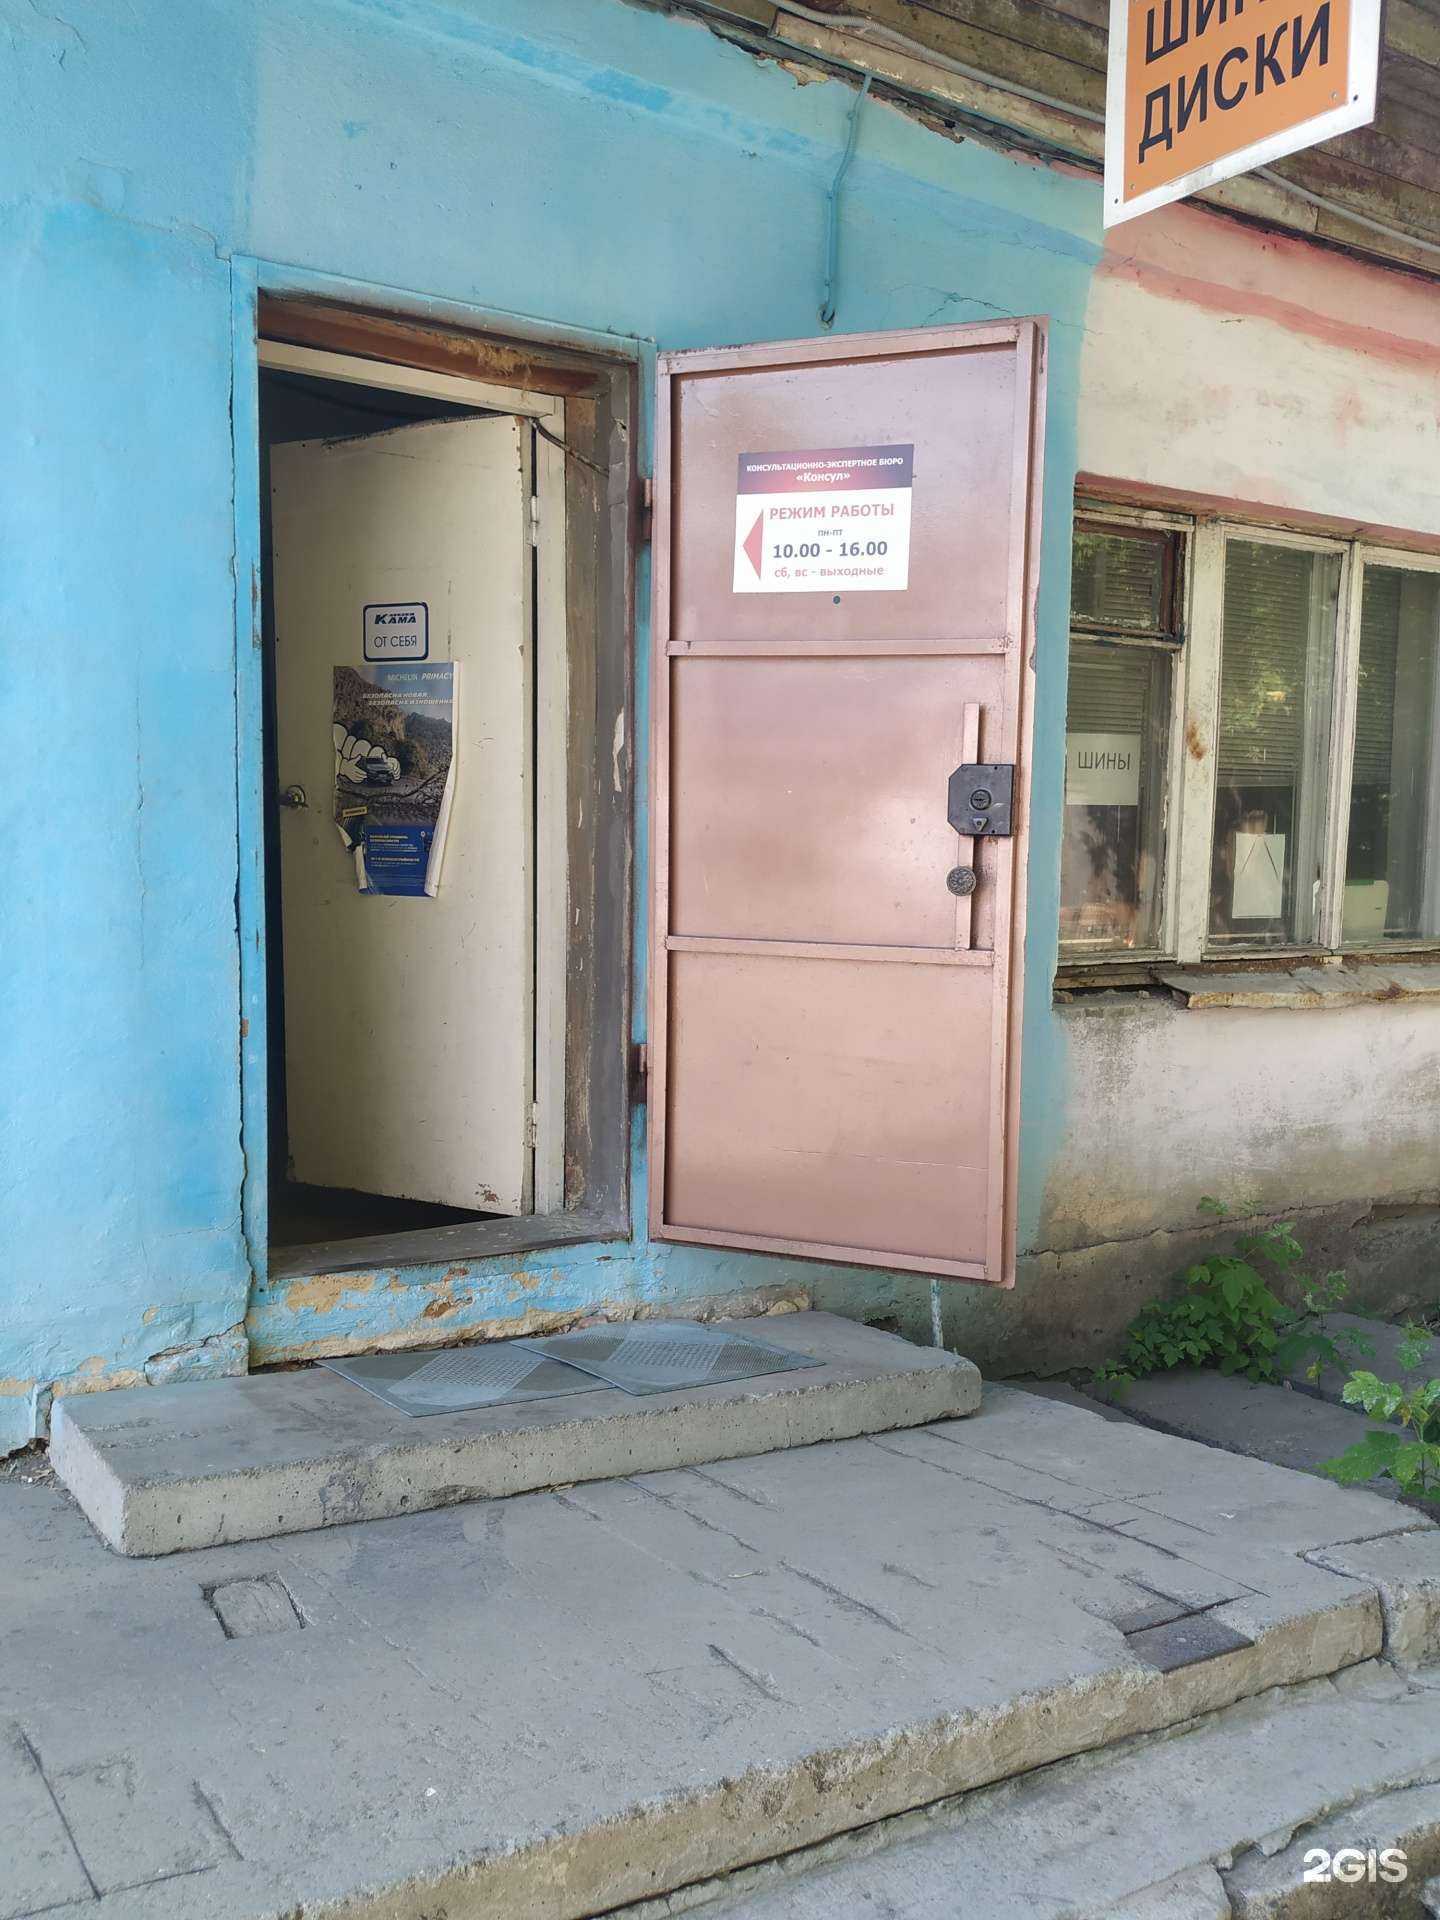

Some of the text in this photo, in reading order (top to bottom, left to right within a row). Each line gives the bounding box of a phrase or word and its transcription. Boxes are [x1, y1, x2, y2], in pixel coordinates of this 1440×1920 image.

[1146, 0, 1264, 65] ШИ
[1138, 1, 1331, 165] ДИСКИ
[746, 457, 904, 472] КОНСУЛЬТАЦИОННО-ЭКСПЕРТНОЕ БЮРО
[796, 472, 851, 483] «Консул»
[769, 503, 895, 520] РЕЖИМ РАБОТЫ
[773, 543, 821, 559] 10.00
[839, 541, 888, 557] 16.00
[774, 566, 791, 579] сб,
[795, 568, 808, 577] вс
[820, 566, 885, 578] выходные
[374, 635, 417, 648] ОТ СЕБЯ
[1078, 751, 1131, 770] ШИНЫ
